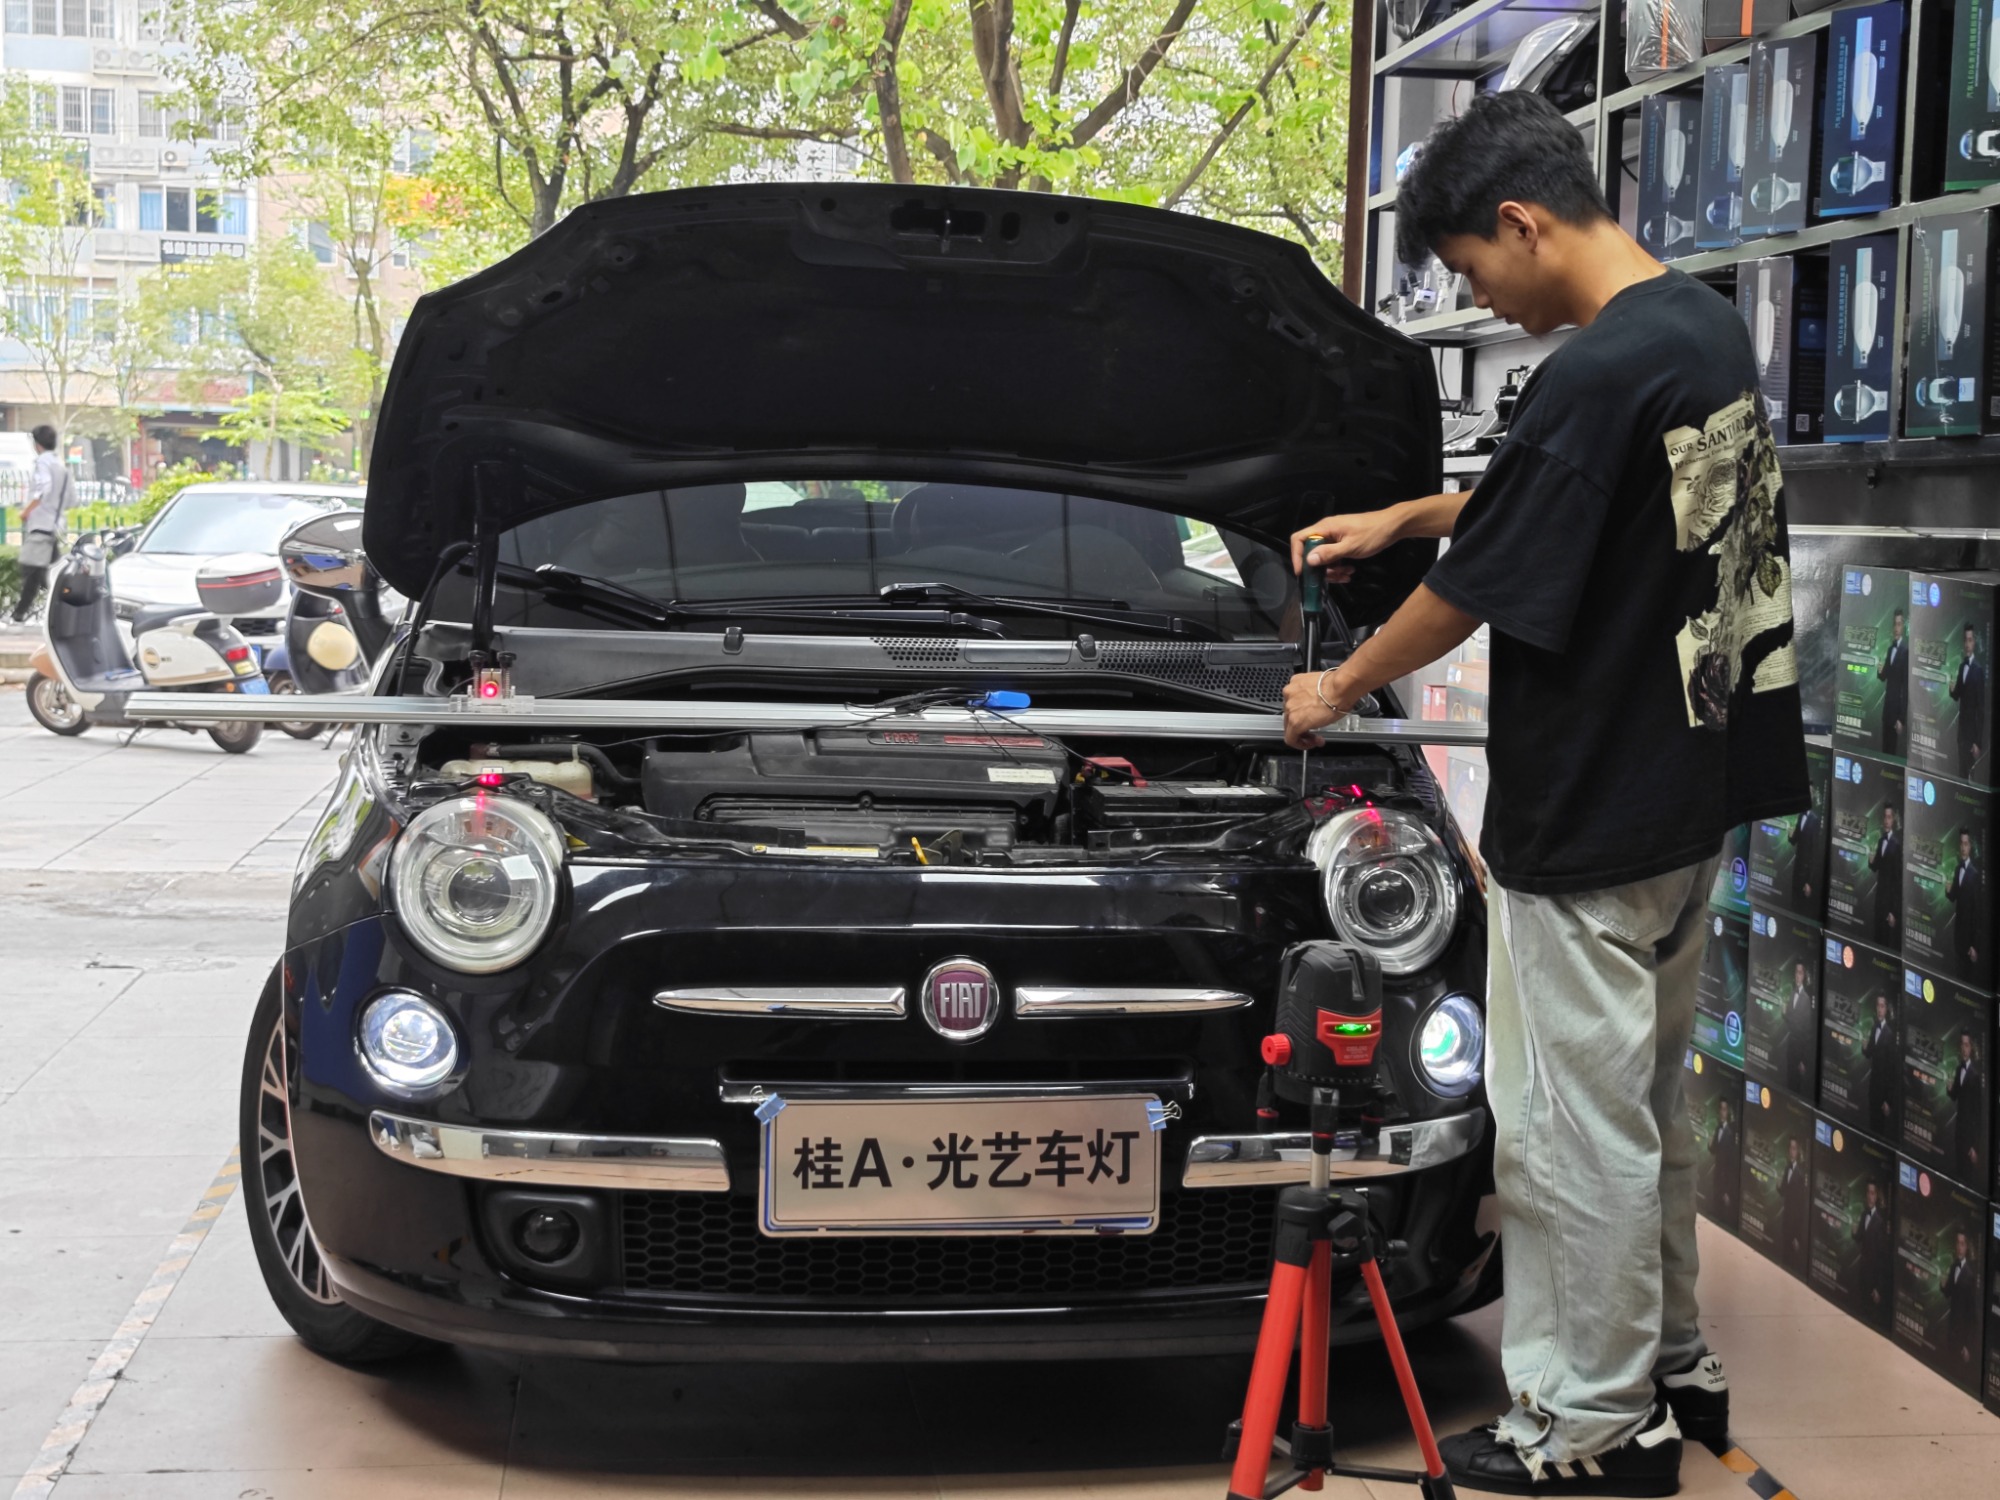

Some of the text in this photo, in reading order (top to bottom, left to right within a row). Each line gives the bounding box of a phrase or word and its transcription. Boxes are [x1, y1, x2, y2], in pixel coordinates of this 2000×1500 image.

[1670, 442, 1694, 456] OUR
[883, 732, 920, 744] FIAT
[939, 982, 984, 1019] FIAT
[793, 1128, 1140, 1190] 桂A·光艺车灯
